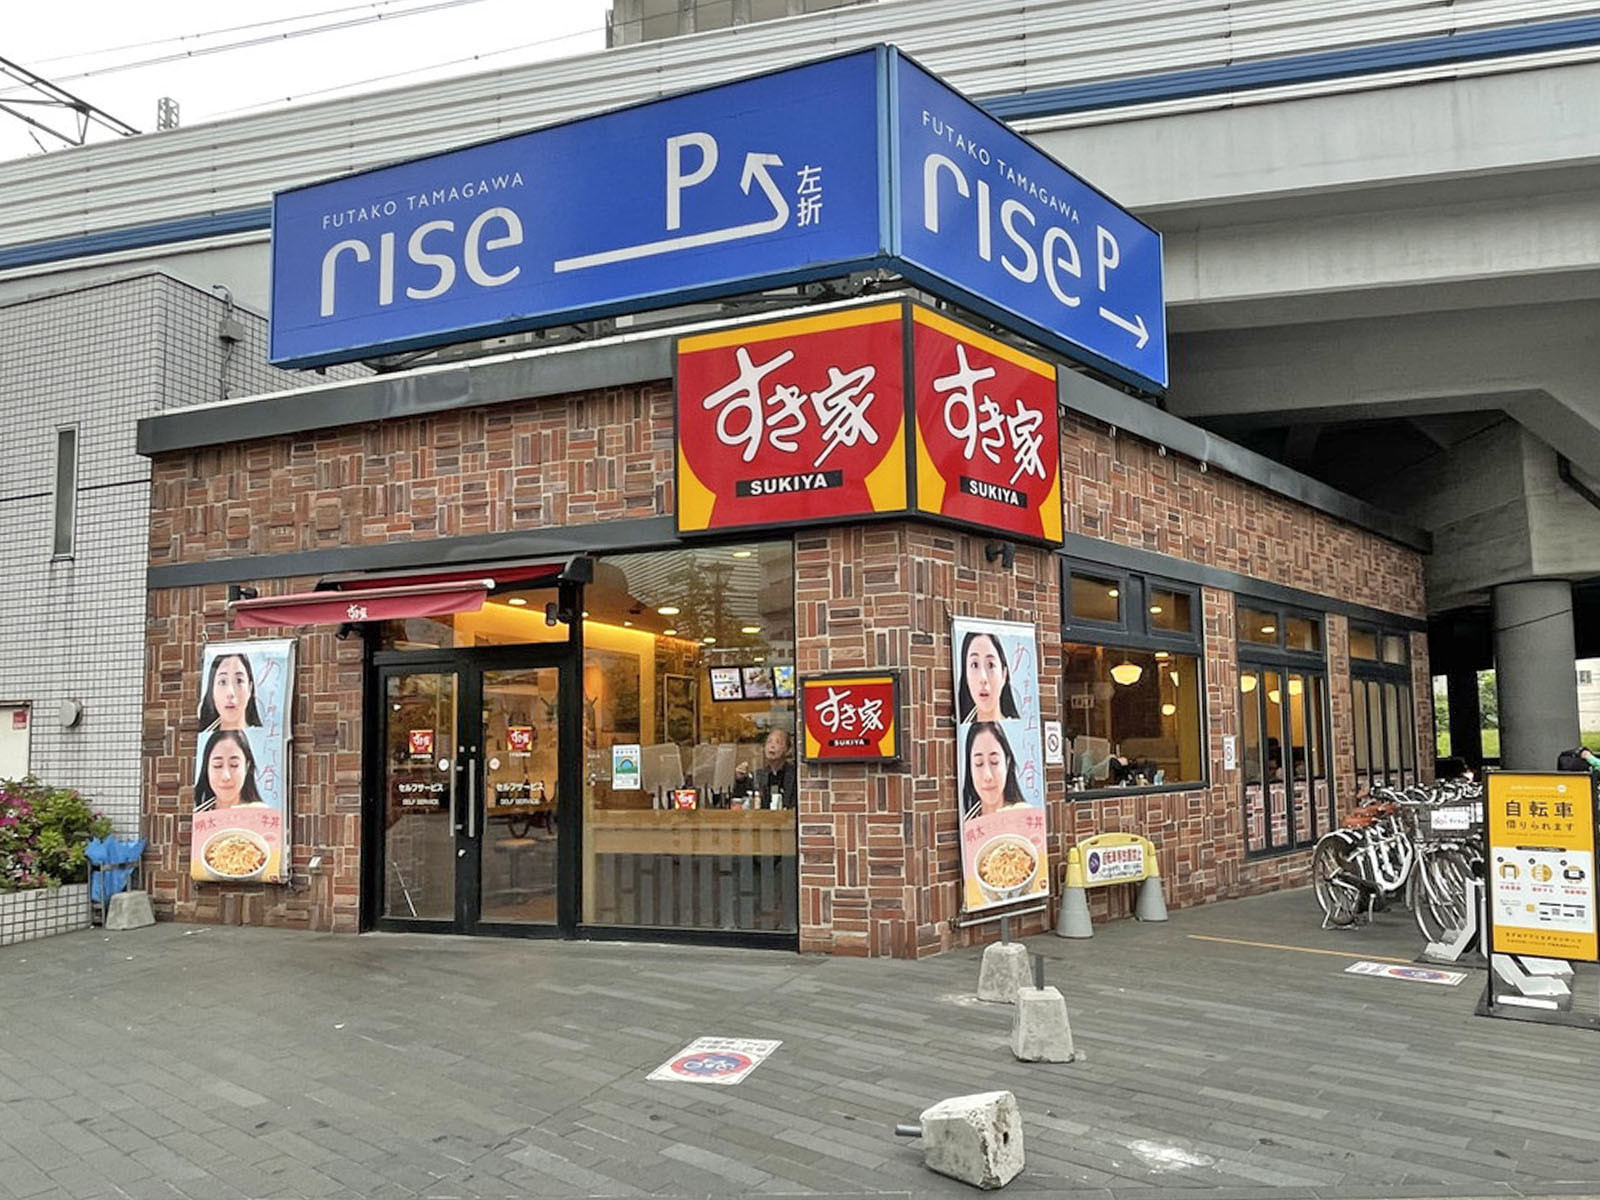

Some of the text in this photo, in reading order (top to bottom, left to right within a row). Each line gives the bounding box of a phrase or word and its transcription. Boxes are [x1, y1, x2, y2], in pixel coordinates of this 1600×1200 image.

[665, 132, 718, 230] P
[796, 164, 823, 226] 左折
[922, 110, 1081, 225] FUTAKO TAMAGAWA
[322, 171, 524, 230] FUTAKO TAMAGAWA
[923, 153, 1082, 308] rise
[1097, 225, 1121, 292] P
[319, 206, 524, 318] rise
[703, 346, 879, 468] すき家
[933, 343, 1047, 486] すき家
[750, 472, 829, 497] SUKIYA
[969, 480, 1019, 506] SUKIYA
[814, 687, 884, 737] すき家
[834, 739, 865, 747] SUKIYA
[398, 783, 444, 793] セルフサービス
[496, 782, 545, 792] セルフサービス
[1506, 800, 1574, 818] 自転車
[1506, 820, 1575, 831] 借りられます
